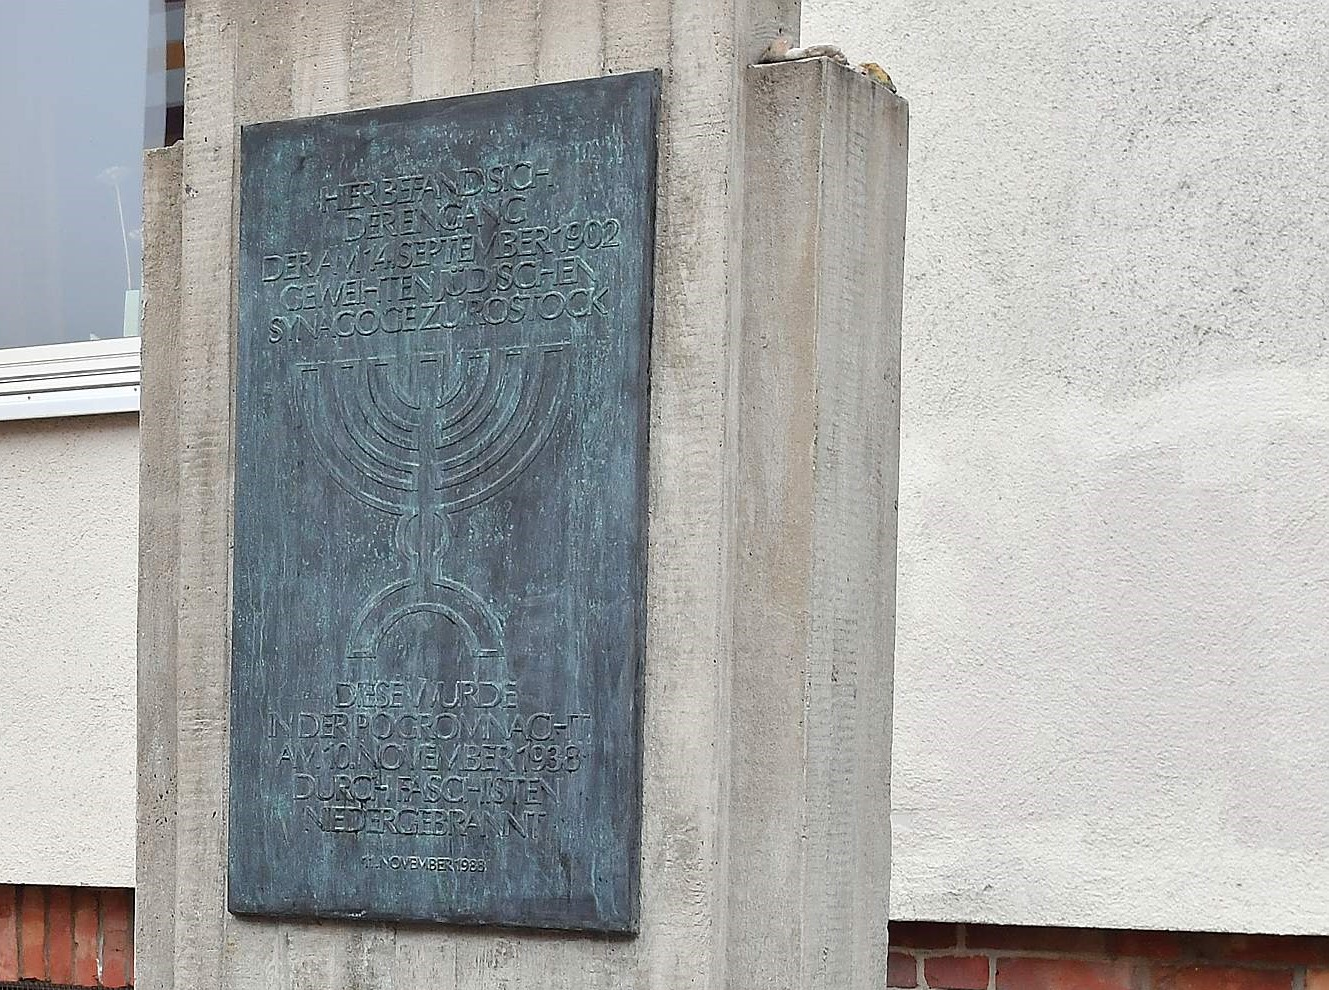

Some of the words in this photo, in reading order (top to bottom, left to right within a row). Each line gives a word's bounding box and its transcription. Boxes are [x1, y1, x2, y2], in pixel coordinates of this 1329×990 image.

[381, 168, 486, 206] BEFAND
[487, 161, 554, 193] SICH
[344, 210, 398, 242] DER
[261, 251, 316, 282] DER
[316, 245, 360, 277] AM
[397, 225, 553, 269] SEPTEMBER
[551, 218, 621, 252] 1902
[280, 271, 435, 311] GEWEIHTEN
[436, 256, 597, 302] JÜDISCHEN
[269, 305, 416, 343] SYNAGOGE
[420, 299, 464, 331] ZU
[467, 287, 609, 325] ROSTOCK
[333, 680, 404, 708] DIESE
[408, 679, 517, 708] WURDE
[268, 711, 294, 738] IN
[297, 711, 350, 738] DER
[353, 711, 591, 743] POGROMNACHT
[275, 742, 321, 769] AM
[357, 740, 515, 772] NOVEMBER
[517, 741, 582, 773] 1938
[293, 773, 390, 801] DURCH
[397, 775, 563, 806] FASCHISTEN
[304, 806, 546, 838] NIEDERGEBRANNT
[381, 854, 454, 871] NOVEMBER
